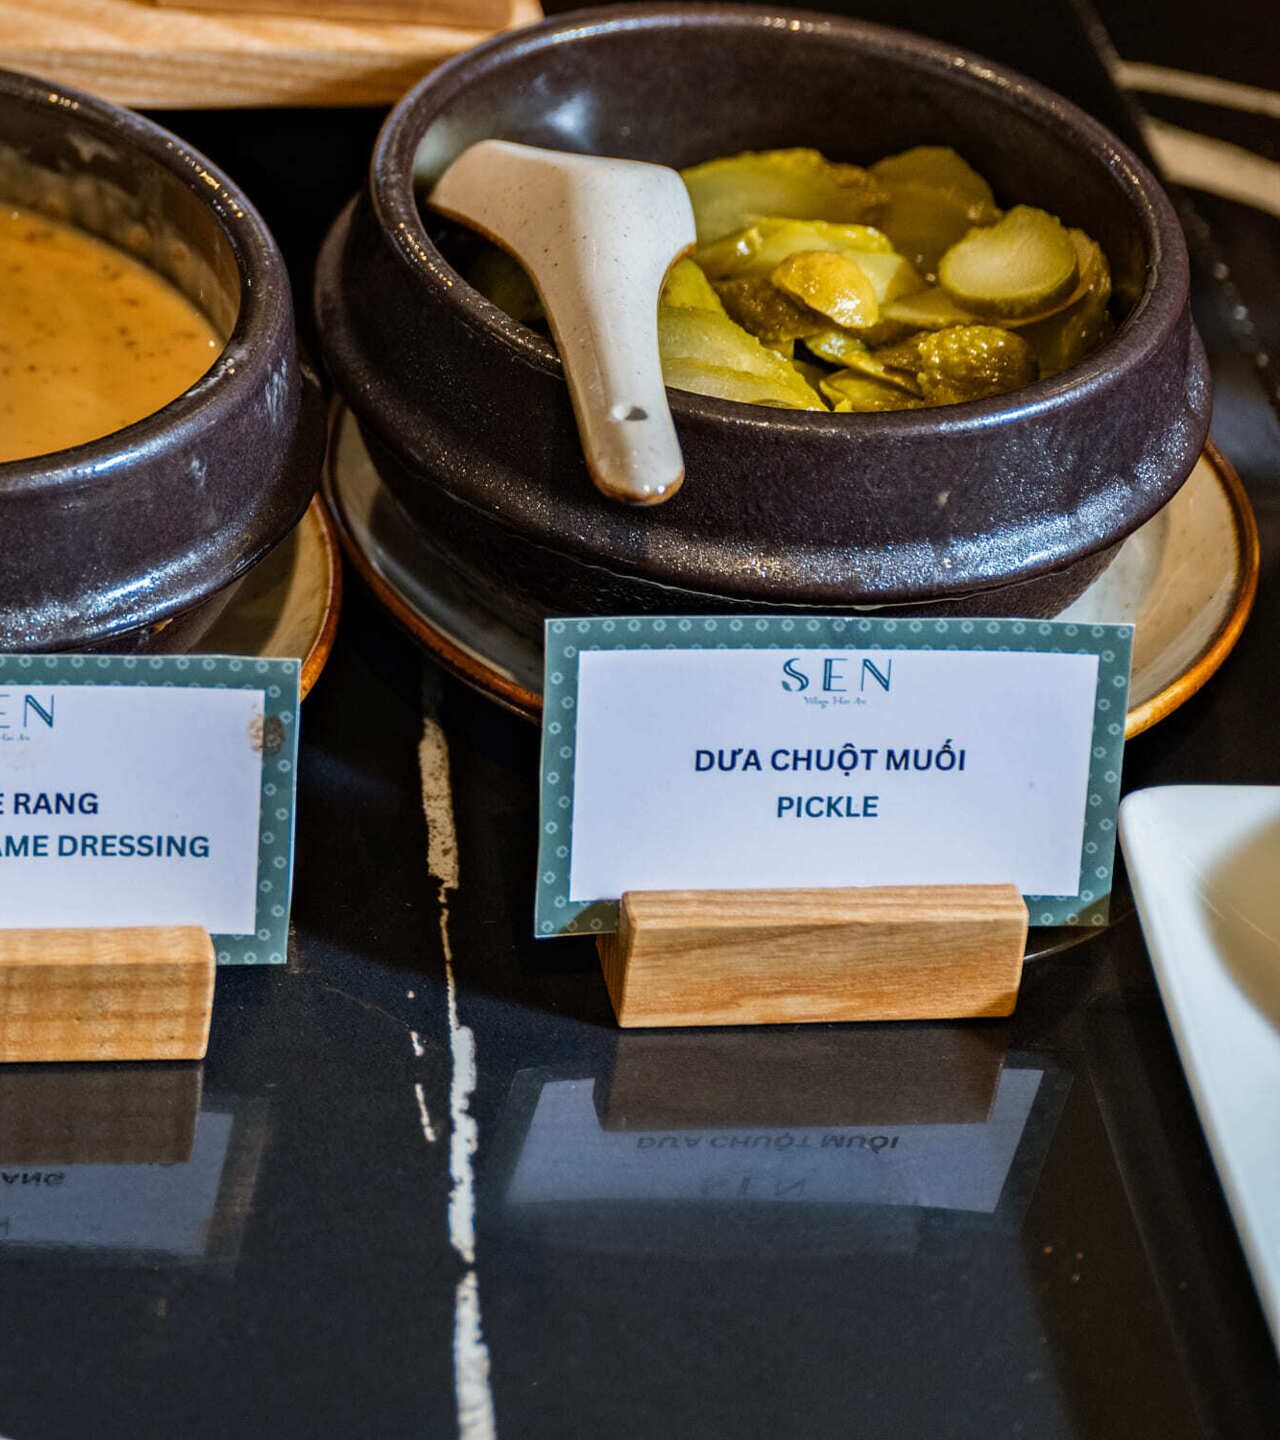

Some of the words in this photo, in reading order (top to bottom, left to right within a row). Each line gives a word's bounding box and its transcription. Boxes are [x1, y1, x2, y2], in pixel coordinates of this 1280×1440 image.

[781, 657, 892, 692] SEN
[695, 748, 762, 771] DƯA
[771, 743, 878, 777] CHUỘT
[886, 738, 966, 771] MUỐI
[14, 792, 99, 815] RANG
[777, 796, 879, 818] PICKLE
[58, 834, 210, 858] DRESSING
